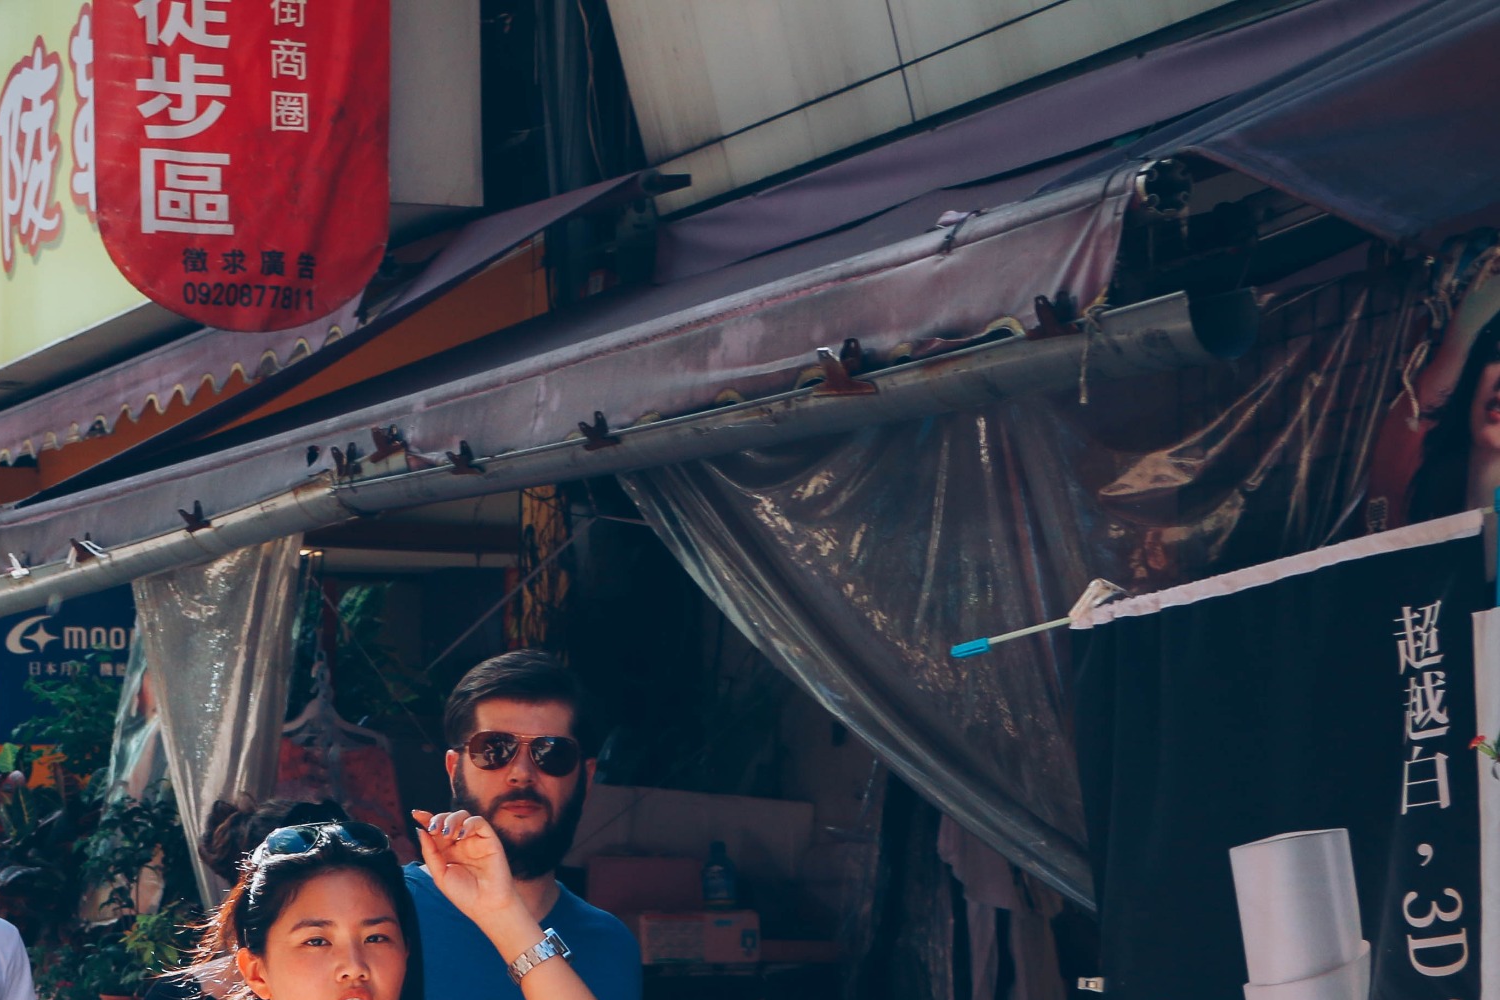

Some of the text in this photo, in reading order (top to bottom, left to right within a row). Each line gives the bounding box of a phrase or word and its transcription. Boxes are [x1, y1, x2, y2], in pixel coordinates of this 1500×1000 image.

[182, 248, 317, 281] 徵求廣告
[182, 281, 315, 312] 0920877811
